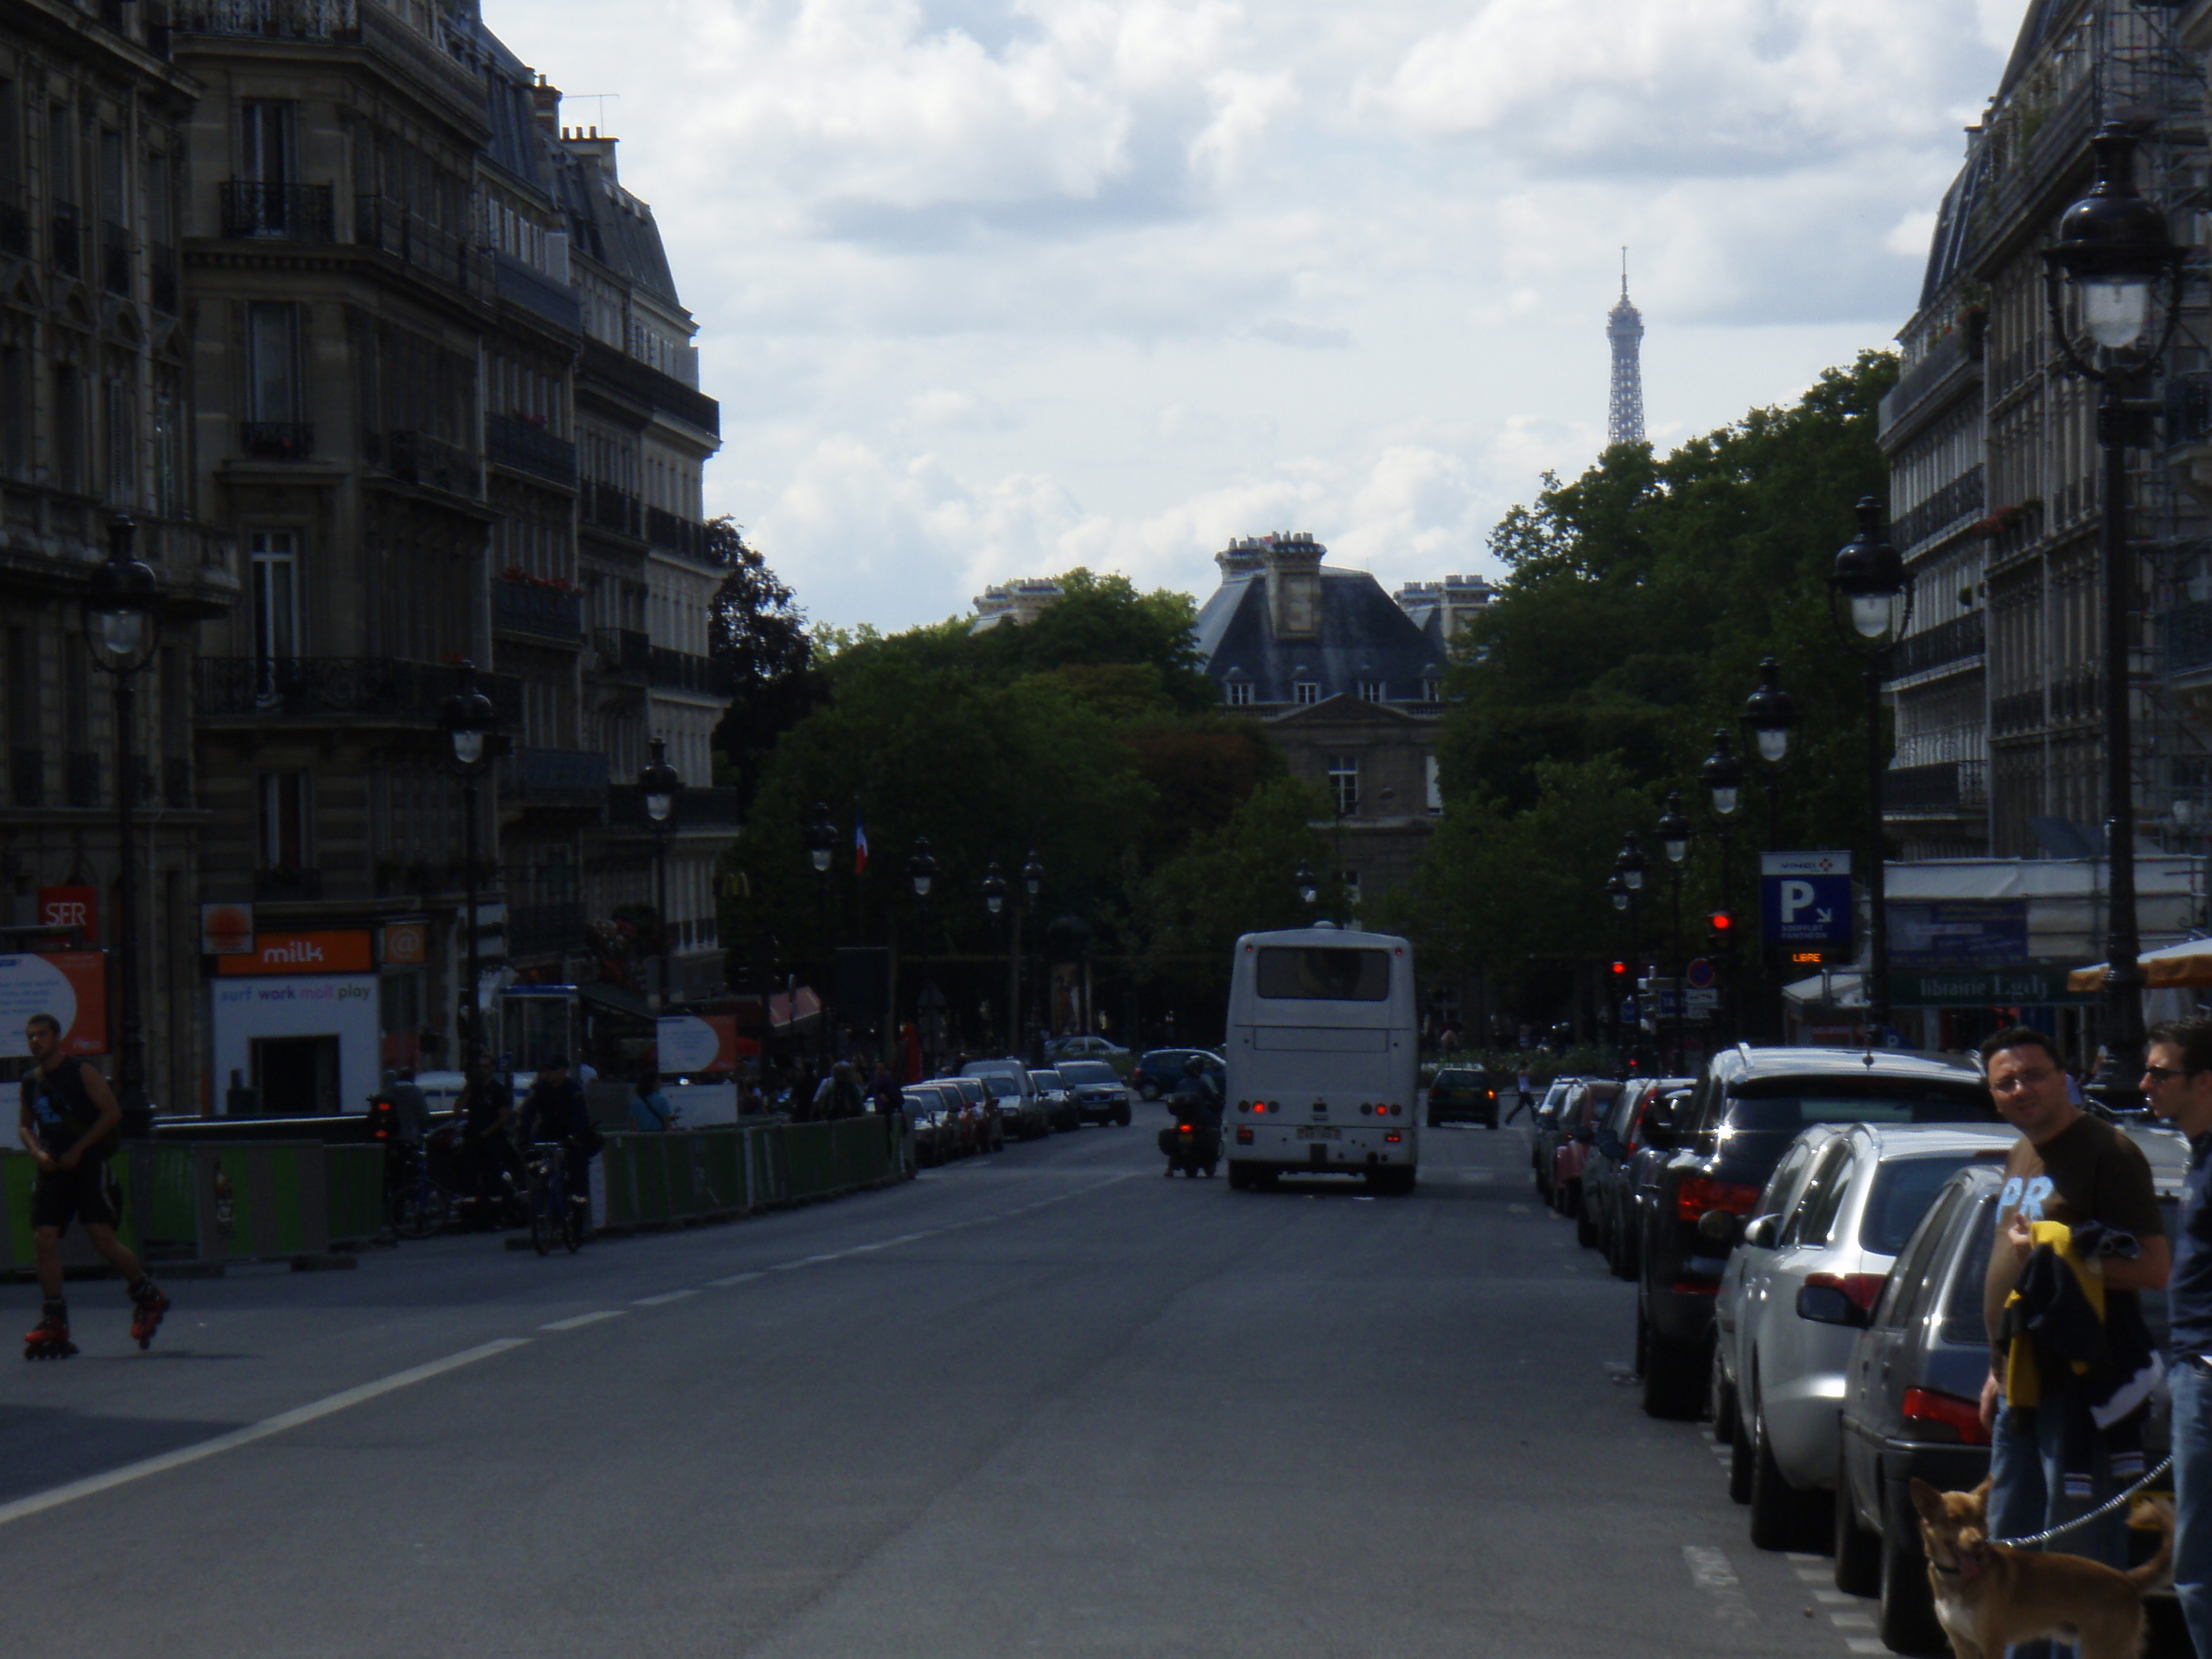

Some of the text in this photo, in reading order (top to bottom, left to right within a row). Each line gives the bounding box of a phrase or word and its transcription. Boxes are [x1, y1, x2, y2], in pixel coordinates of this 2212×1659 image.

[1781, 880, 1815, 923] P
[263, 940, 324, 964] milk
[1792, 953, 1822, 963] LIBRE
[221, 984, 371, 1002] surf work mail play
[1920, 978, 1986, 996] librairie
